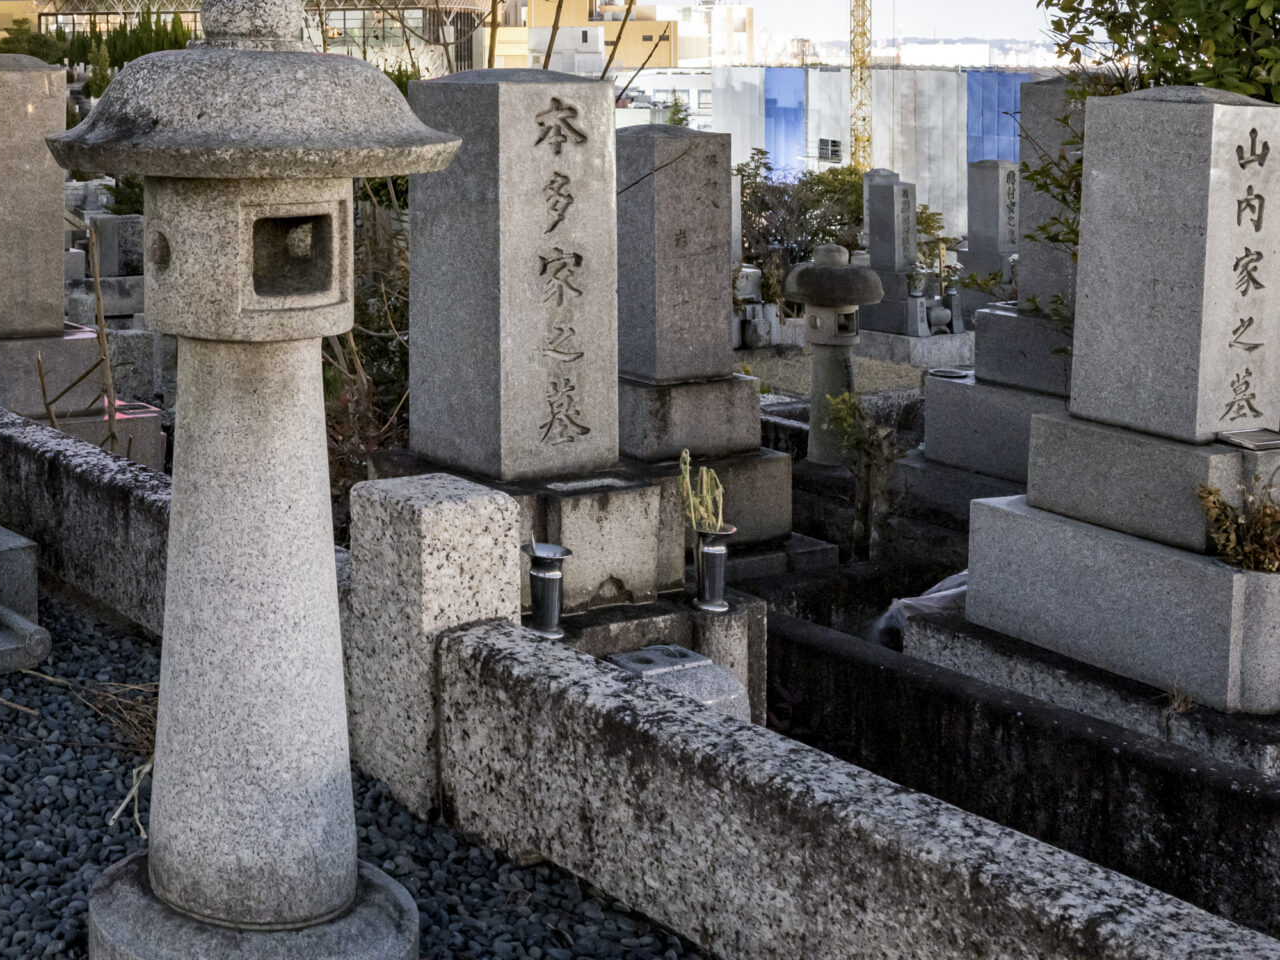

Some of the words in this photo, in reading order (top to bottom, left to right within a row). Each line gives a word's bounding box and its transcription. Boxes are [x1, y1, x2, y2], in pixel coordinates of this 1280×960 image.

[534, 96, 591, 446] 本多家之墓
[1219, 127, 1271, 422] 山内家之墓
